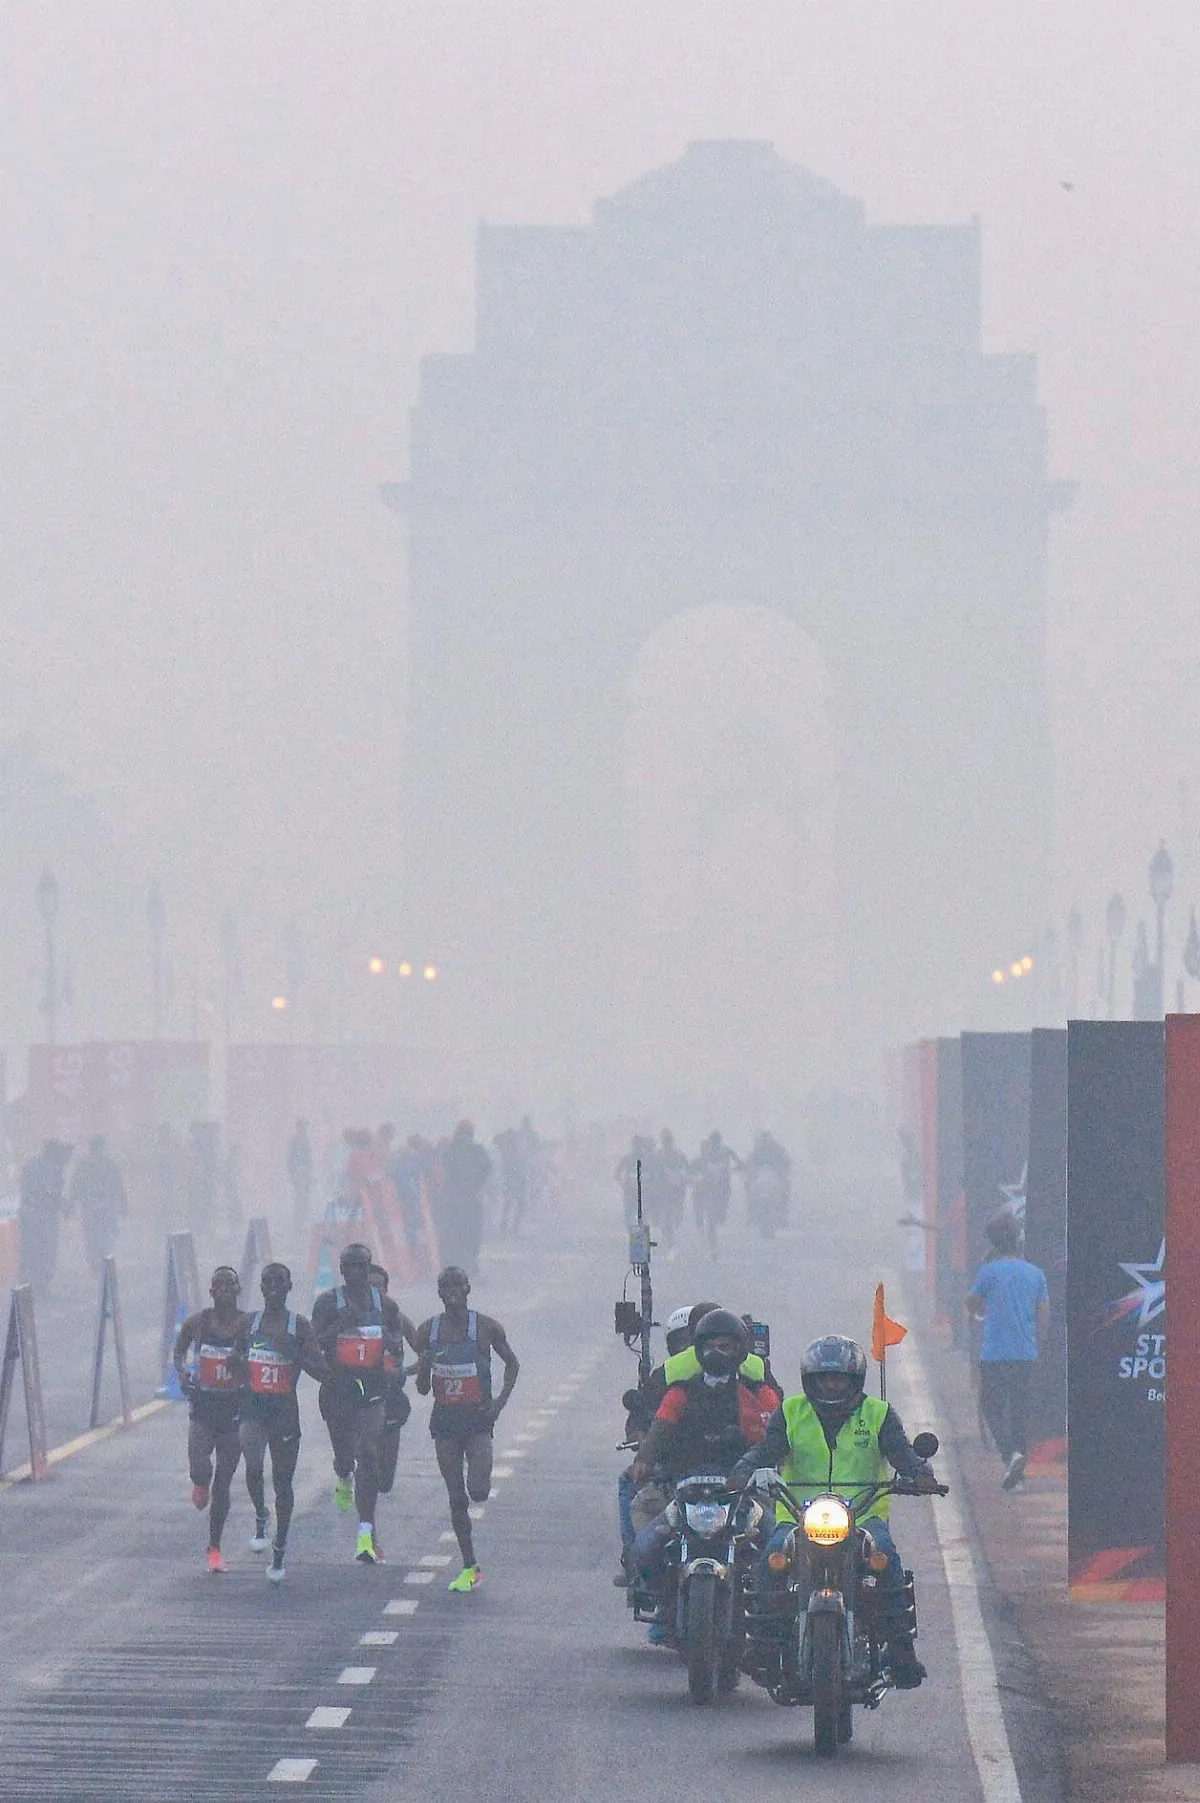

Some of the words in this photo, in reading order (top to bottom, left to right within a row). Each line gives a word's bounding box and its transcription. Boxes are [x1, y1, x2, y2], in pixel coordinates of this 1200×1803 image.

[357, 1344, 366, 1361] 1
[1136, 1334, 1166, 1356] ST
[260, 1365, 279, 1384] 21
[443, 1379, 464, 1396] 22
